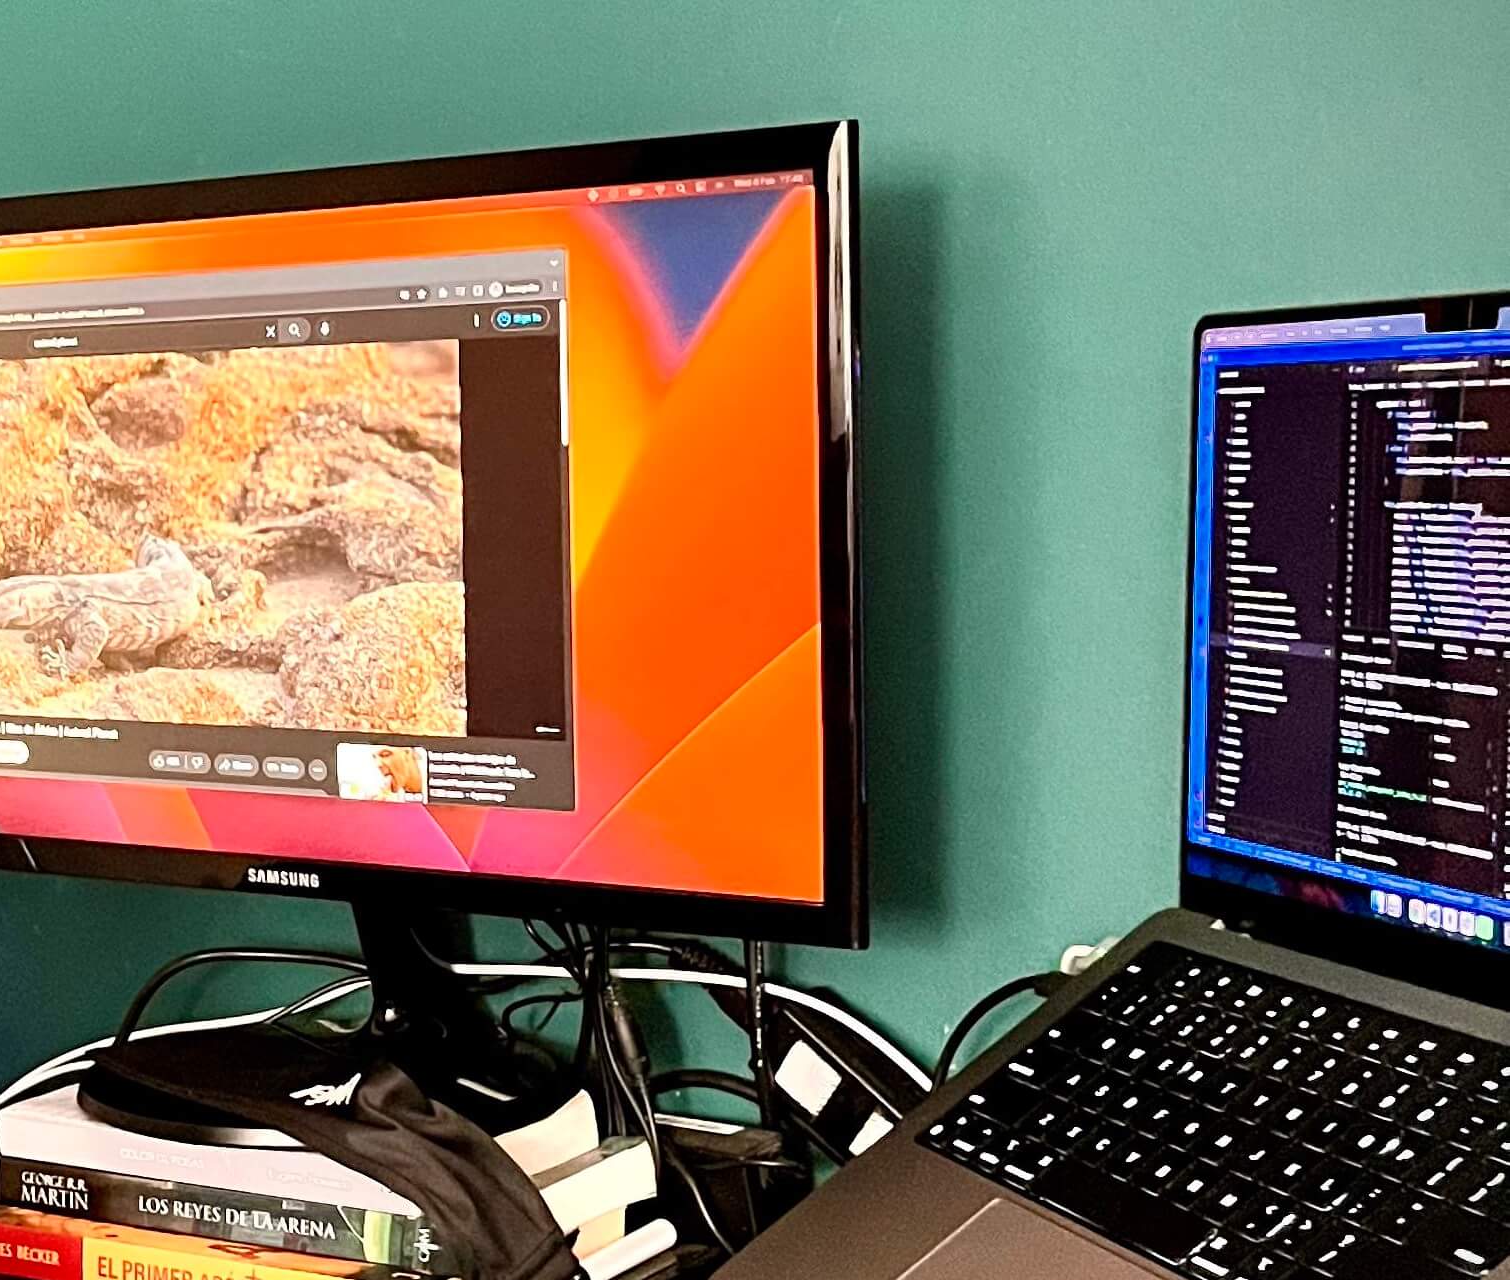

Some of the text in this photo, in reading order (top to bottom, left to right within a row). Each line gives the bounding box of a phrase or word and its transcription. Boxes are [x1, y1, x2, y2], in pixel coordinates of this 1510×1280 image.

[248, 867, 320, 889] SAMSUNG
[21, 1171, 65, 1188] GEORGE
[21, 1184, 89, 1210] MARTIN
[138, 1195, 336, 1240] LOS REYES DE LA ARENA
[17, 1245, 61, 1266] BECKER
[98, 1256, 118, 1280] EL
